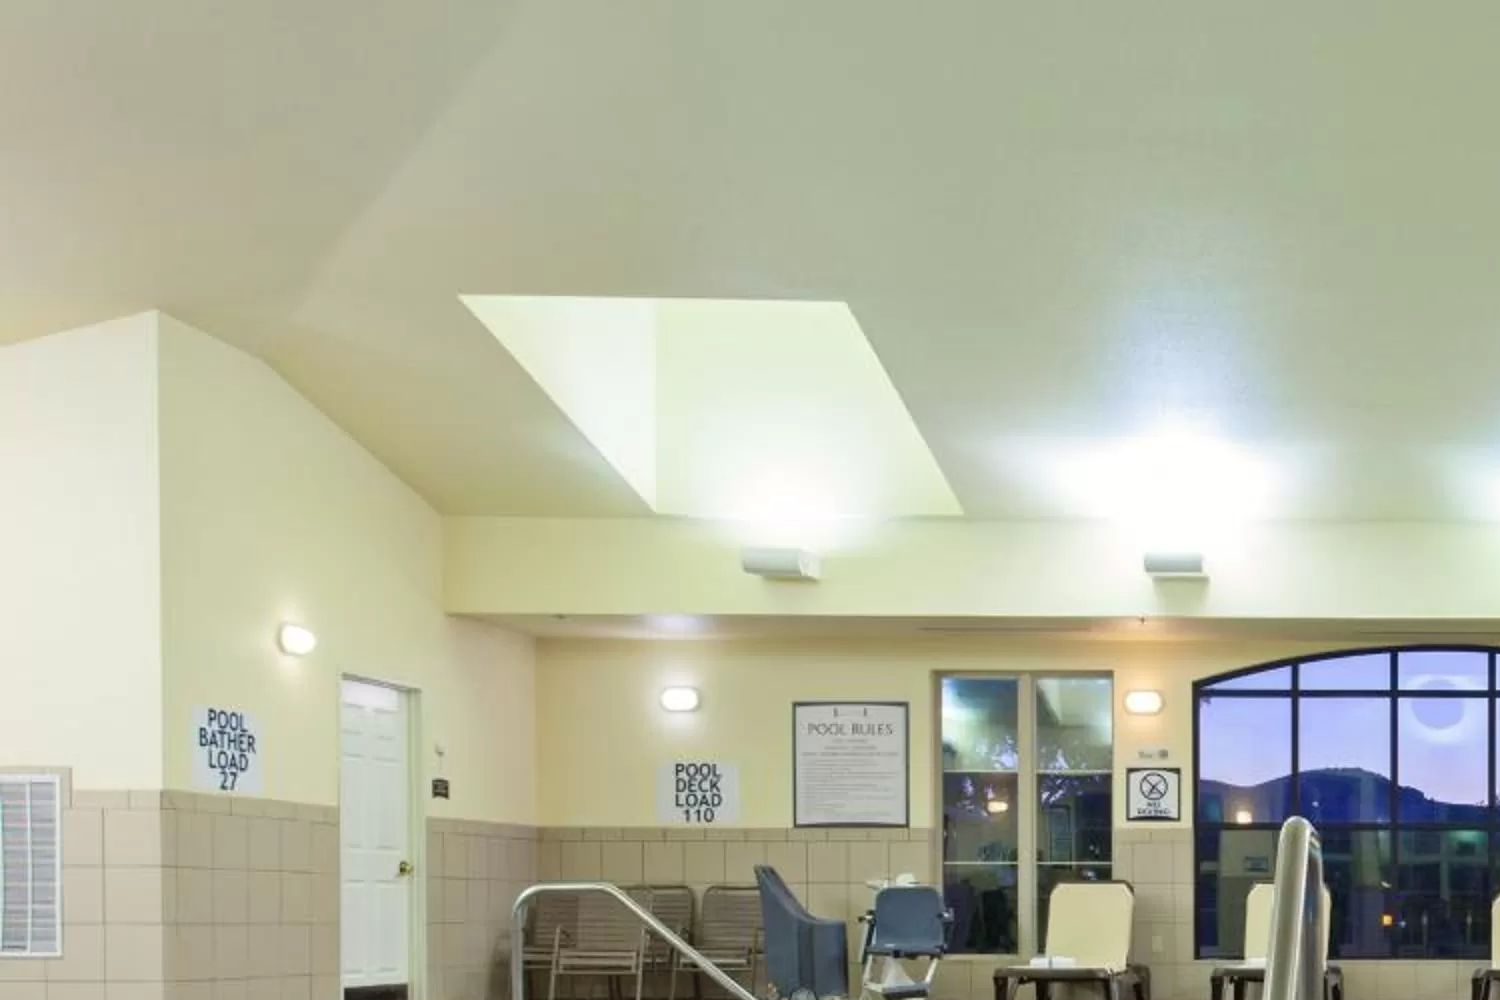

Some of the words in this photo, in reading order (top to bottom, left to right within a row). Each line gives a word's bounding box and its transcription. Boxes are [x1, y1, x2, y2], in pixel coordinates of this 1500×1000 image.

[207, 708, 248, 733] POOL
[199, 727, 256, 754] BATHER
[208, 749, 249, 772] LOAD
[675, 763, 722, 779] POOL
[219, 771, 238, 790] 27
[675, 777, 721, 793] DECK
[675, 793, 722, 808] LOAD
[683, 807, 715, 823] 110
